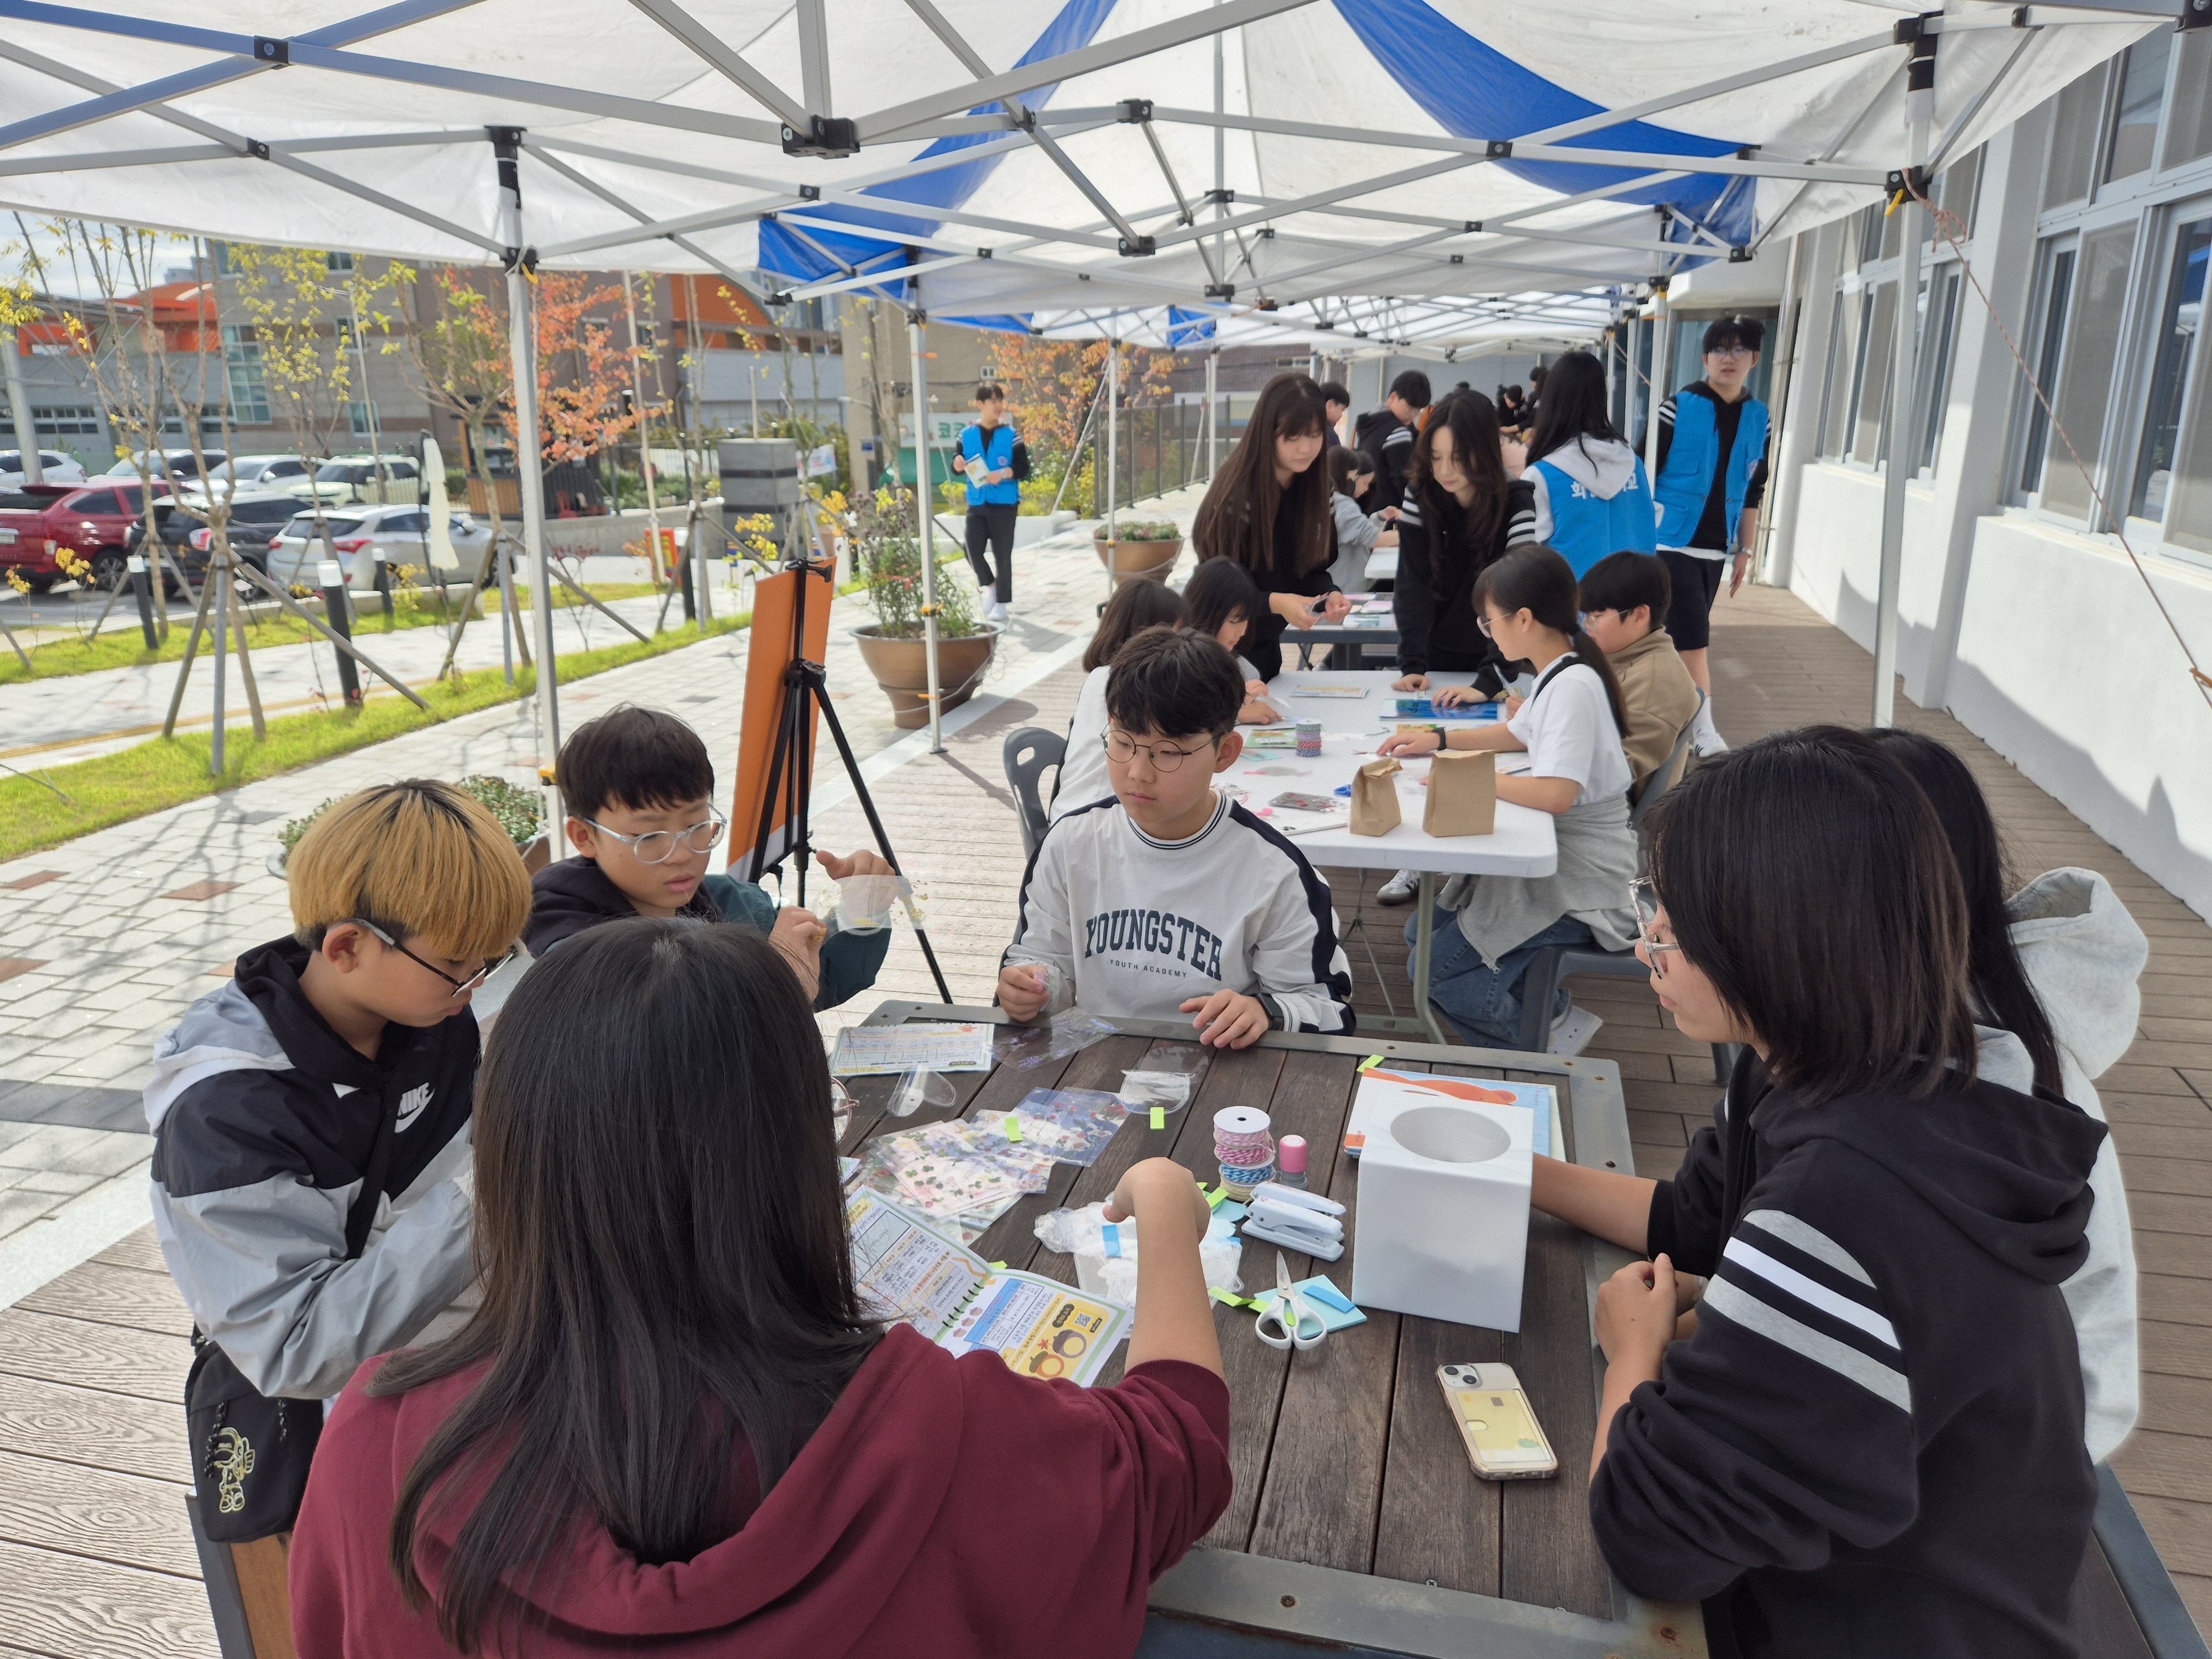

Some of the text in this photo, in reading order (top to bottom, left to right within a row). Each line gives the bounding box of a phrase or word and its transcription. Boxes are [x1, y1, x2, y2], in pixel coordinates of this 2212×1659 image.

[1085, 909, 1222, 981] YOUNGSTER
[1110, 959, 1187, 978] YOUTH ACADEMY
[398, 1082, 430, 1117] NIKE
